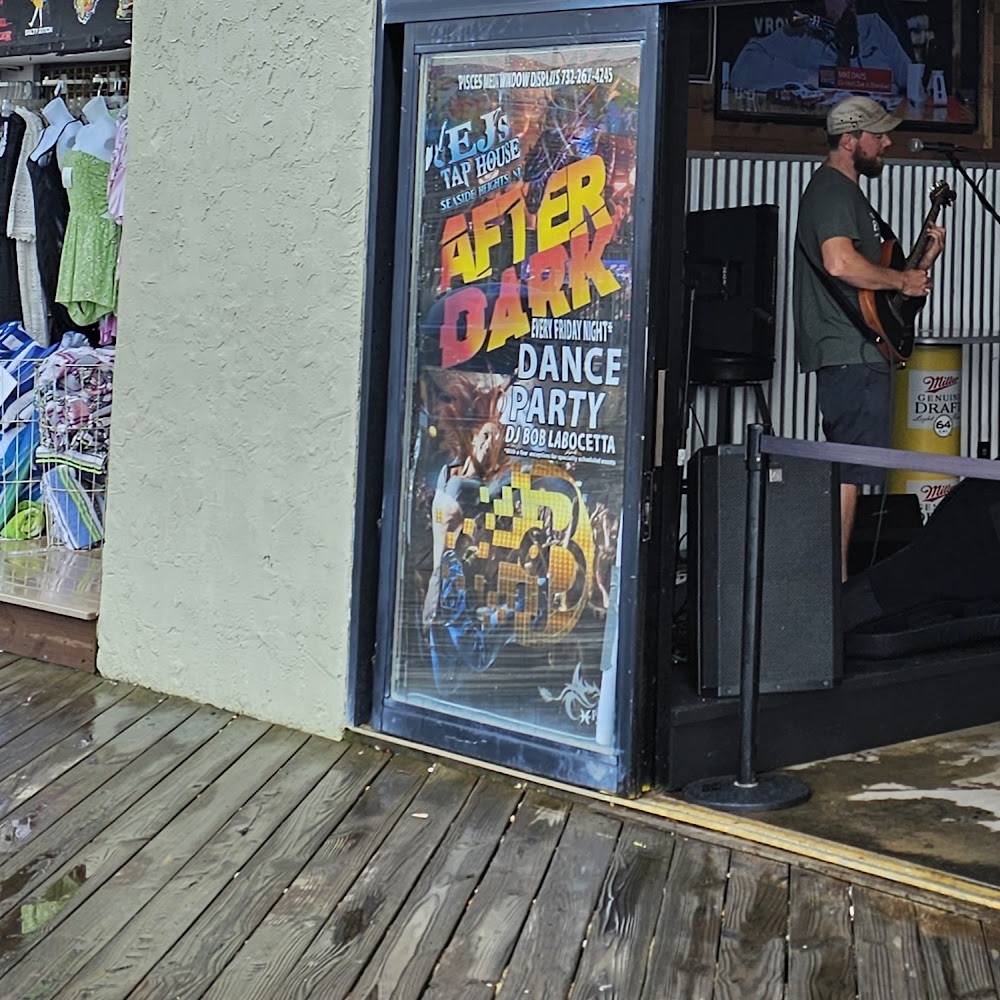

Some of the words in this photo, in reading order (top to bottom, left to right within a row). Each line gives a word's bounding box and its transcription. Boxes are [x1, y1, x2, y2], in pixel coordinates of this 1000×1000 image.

[458, 74, 483, 90] PISCES
[561, 67, 613, 85] 732-267-4245
[440, 161, 472, 190] TAP
[475, 136, 522, 179] HOUSE
[440, 188, 476, 211] SEASIDE
[478, 173, 510, 197] HEIGHTS
[438, 155, 613, 292] AFTER
[440, 223, 622, 369] DARK
[531, 317, 553, 340] EVERY
[554, 318, 582, 341] FRIDAY
[518, 344, 622, 386] DANCE
[922, 376, 960, 393] Miller
[509, 385, 607, 430] PARTY
[935, 420, 952, 429] 64
[504, 425, 521, 445] DJ
[523, 427, 548, 447] BOB
[549, 429, 616, 455] LABOCETTA
[920, 484, 952, 502] Mill
